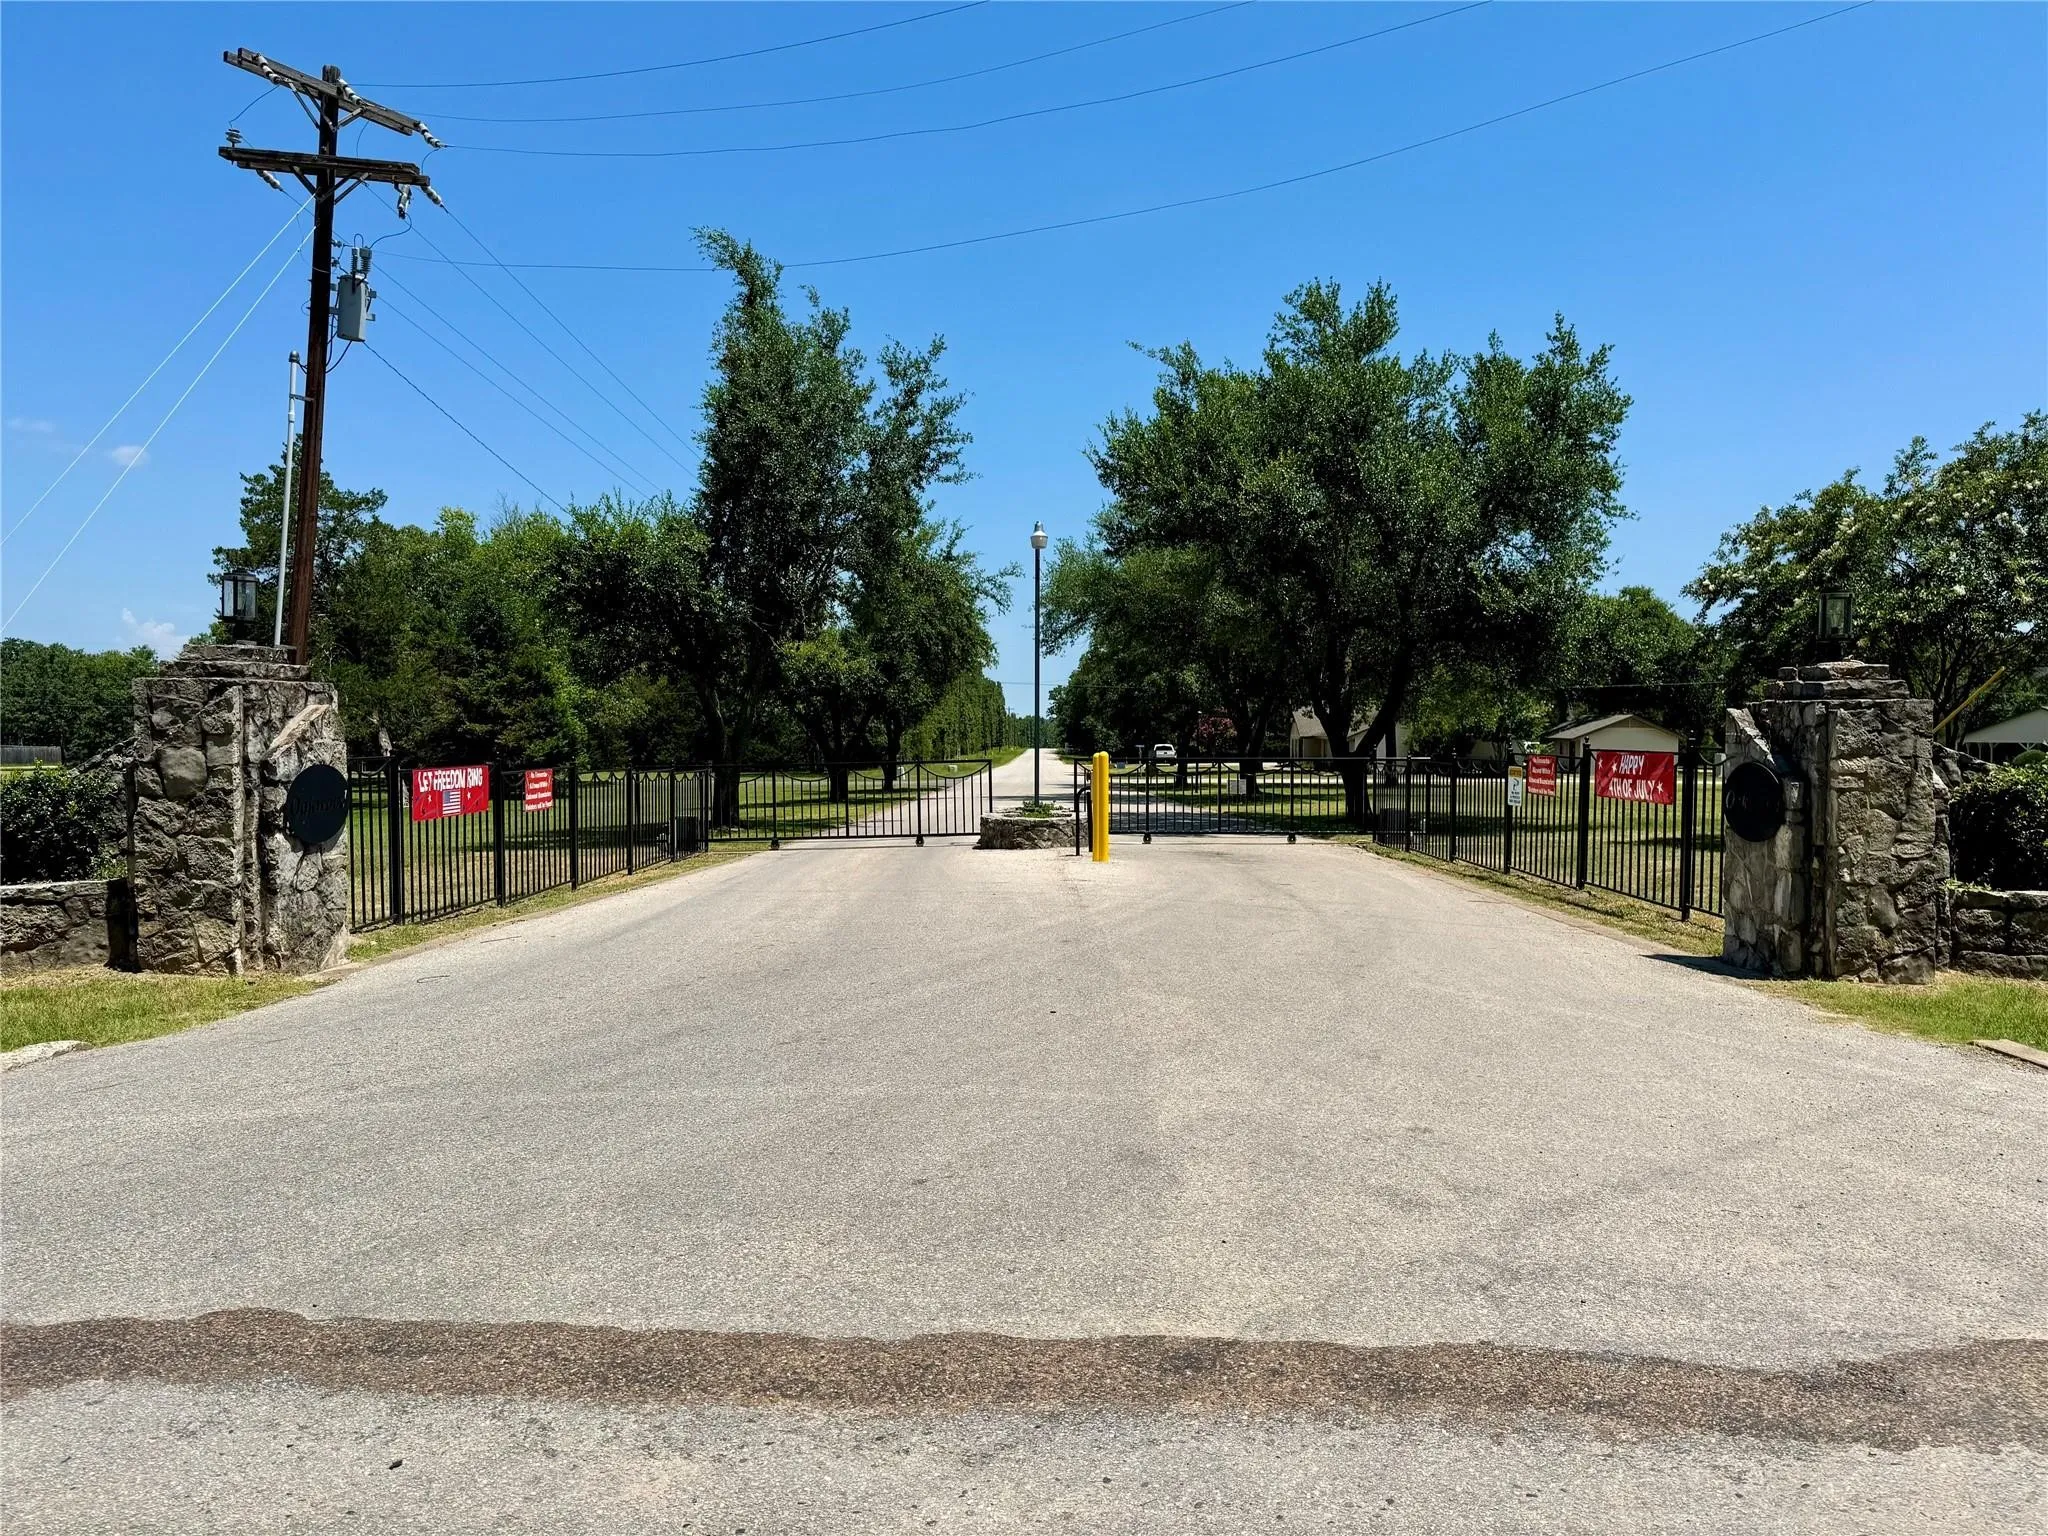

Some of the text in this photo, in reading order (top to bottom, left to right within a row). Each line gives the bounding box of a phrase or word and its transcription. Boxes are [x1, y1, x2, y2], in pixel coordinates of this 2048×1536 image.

[1619, 755, 1645, 775] HAPPY
[418, 768, 483, 793] LET FREEDOM RING
[1609, 777, 1655, 800] 4TH OF JULY
